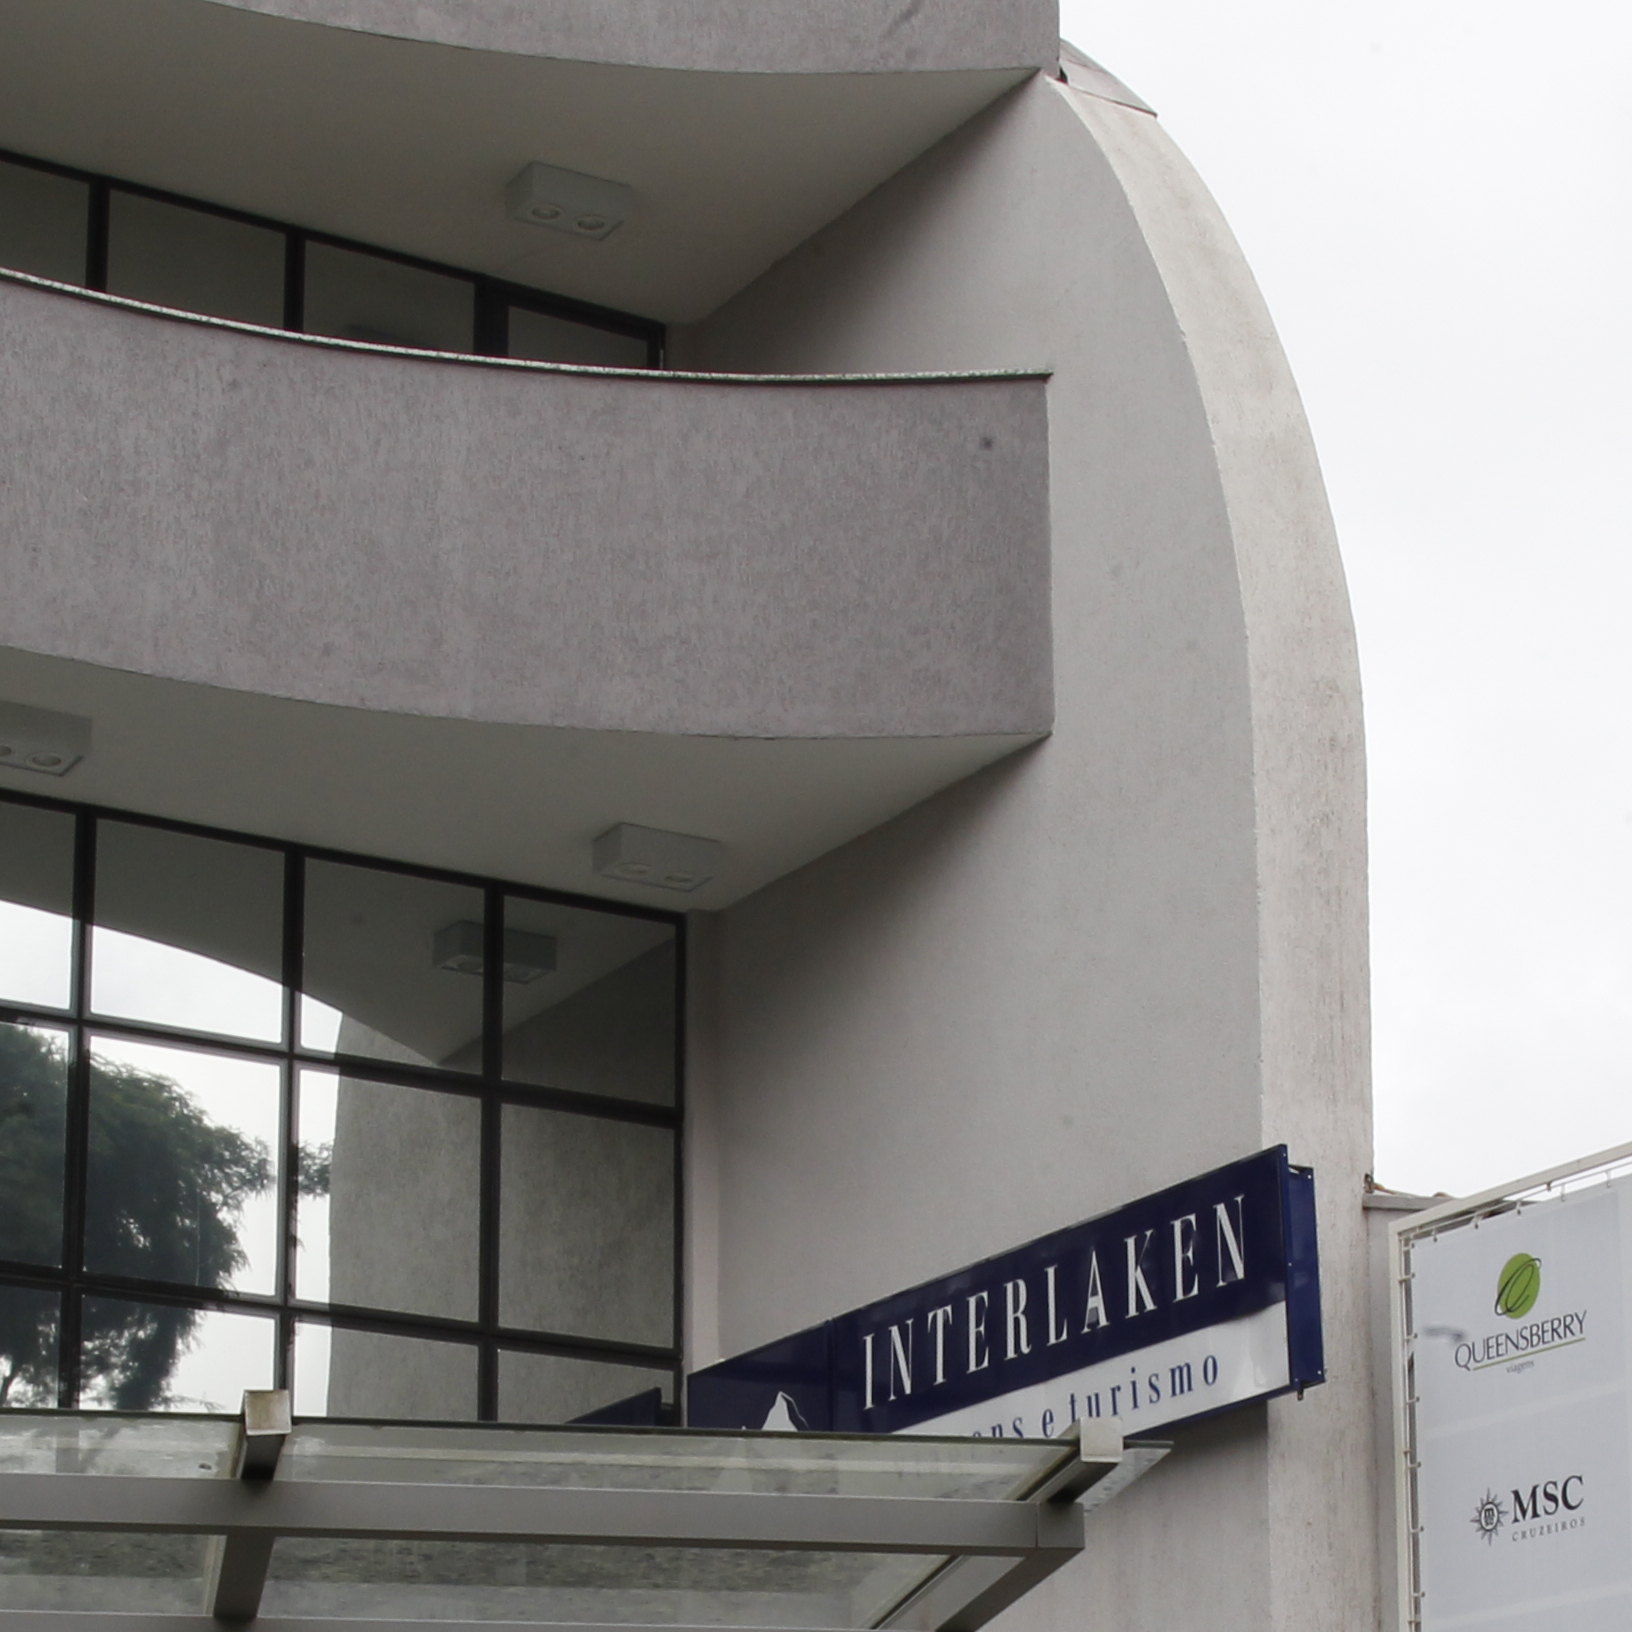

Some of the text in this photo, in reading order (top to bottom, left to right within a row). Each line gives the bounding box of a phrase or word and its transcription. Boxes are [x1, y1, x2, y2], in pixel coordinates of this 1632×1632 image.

[863, 1195, 1247, 1410] INTERLAKEN
[1454, 1310, 1588, 1371] QUEENSBERRY
[1069, 1355, 1219, 1424] turismo
[1511, 1475, 1584, 1524] MSC
[1511, 1516, 1586, 1542] CRUZEIROS
